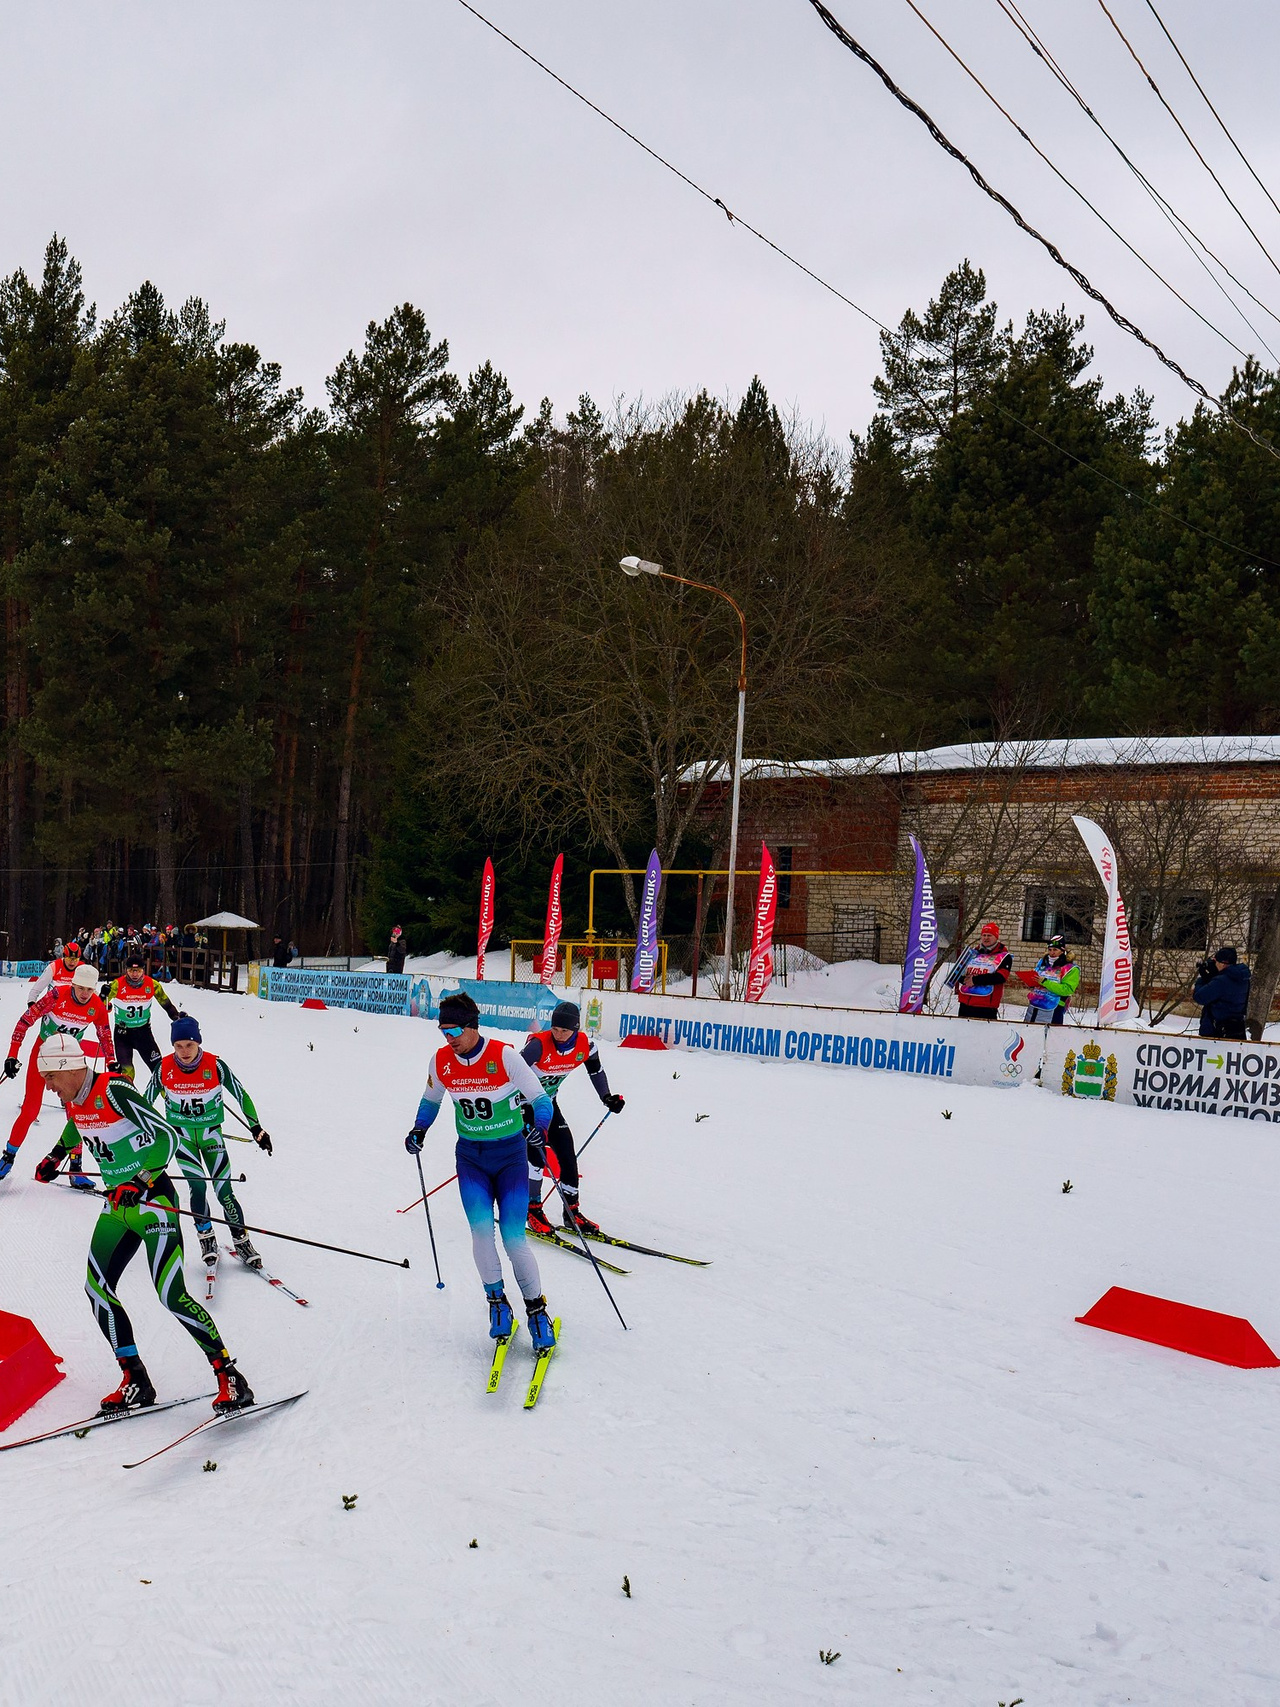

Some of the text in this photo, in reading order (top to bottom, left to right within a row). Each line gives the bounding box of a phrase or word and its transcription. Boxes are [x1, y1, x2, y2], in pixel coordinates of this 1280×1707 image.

[639, 869, 657, 988] СШОР «ОРЛЕНОК»
[909, 957, 929, 1004] СШОР
[1114, 957, 1131, 1011] СШОР
[126, 1005, 144, 1019] 31
[619, 1013, 956, 1078] ПРИВЕТ УЧАСТНИКАМ СОРЕВНОВАНИЙ!
[1136, 1043, 1208, 1072] СПОРТ
[451, 1077, 489, 1086] ФЕДЕРАЦИЯ
[1133, 1068, 1221, 1100] НОРМА
[179, 1097, 206, 1118] 45
[458, 1097, 494, 1121] 69
[484, 1119, 514, 1132] ОБЛАСТИ
[83, 1136, 116, 1163] 24
[135, 1133, 152, 1148] 24
[178, 1292, 220, 1341] RUSSIA
[103, 1410, 131, 1422] MADSHUS
